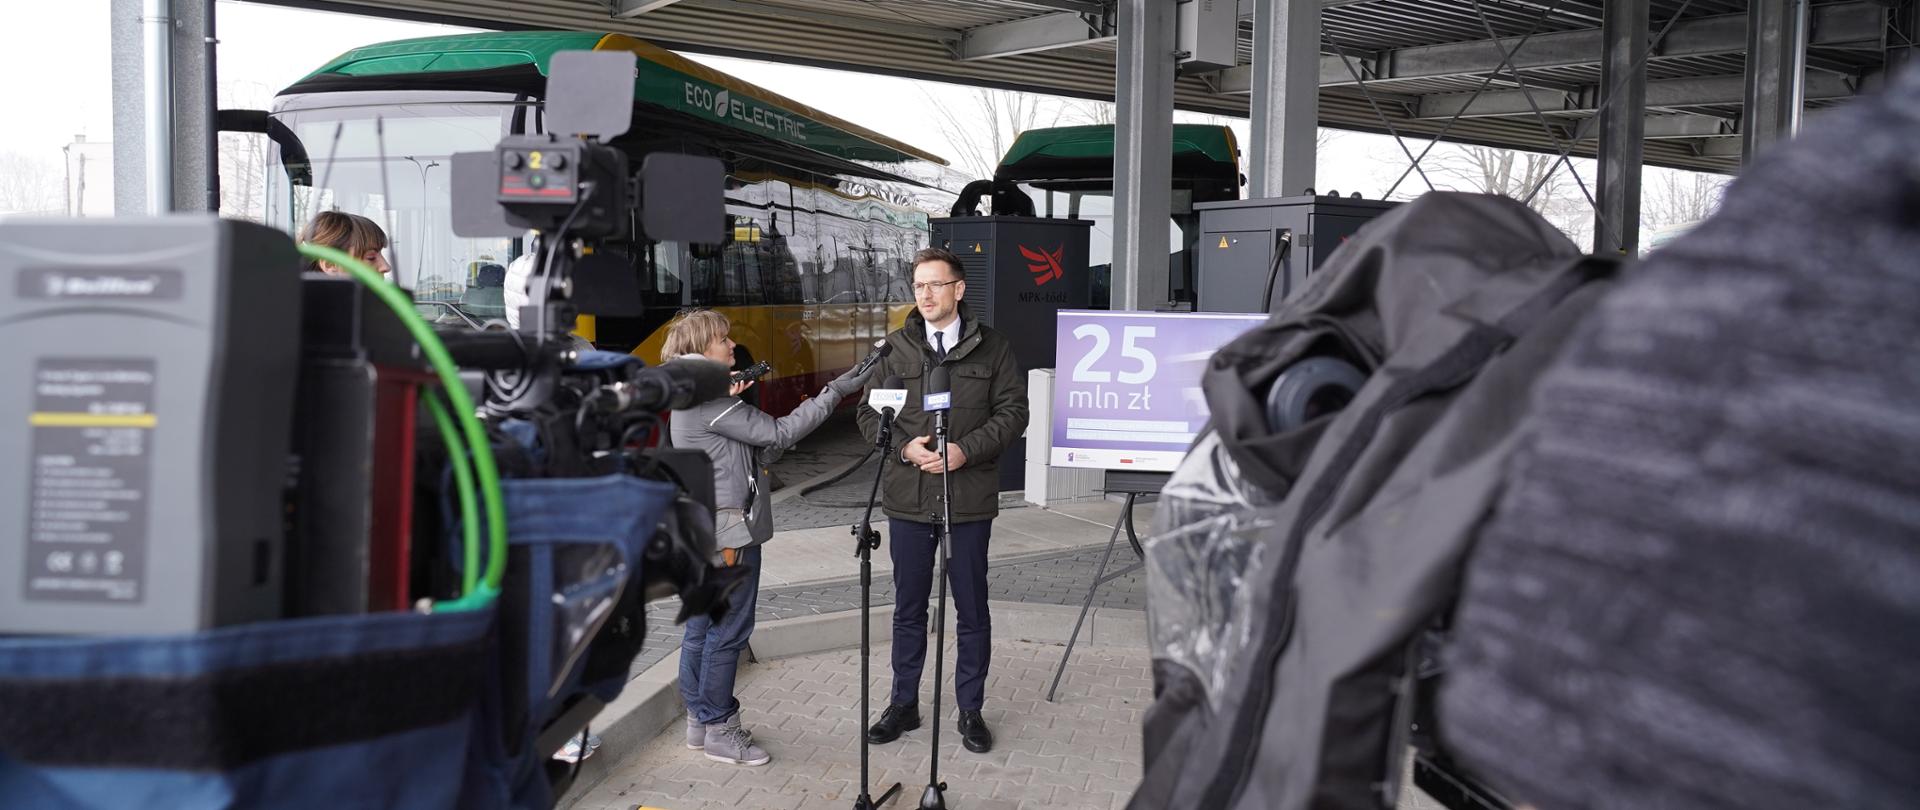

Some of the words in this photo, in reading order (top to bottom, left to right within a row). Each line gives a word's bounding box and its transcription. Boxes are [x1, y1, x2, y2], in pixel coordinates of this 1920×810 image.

[685, 82, 712, 111] ECO
[731, 99, 806, 140] ELECTRIC
[529, 151, 543, 170] 2
[1072, 324, 1157, 384] 25
[1069, 385, 1119, 409] mln
[1128, 384, 1151, 410] zł
